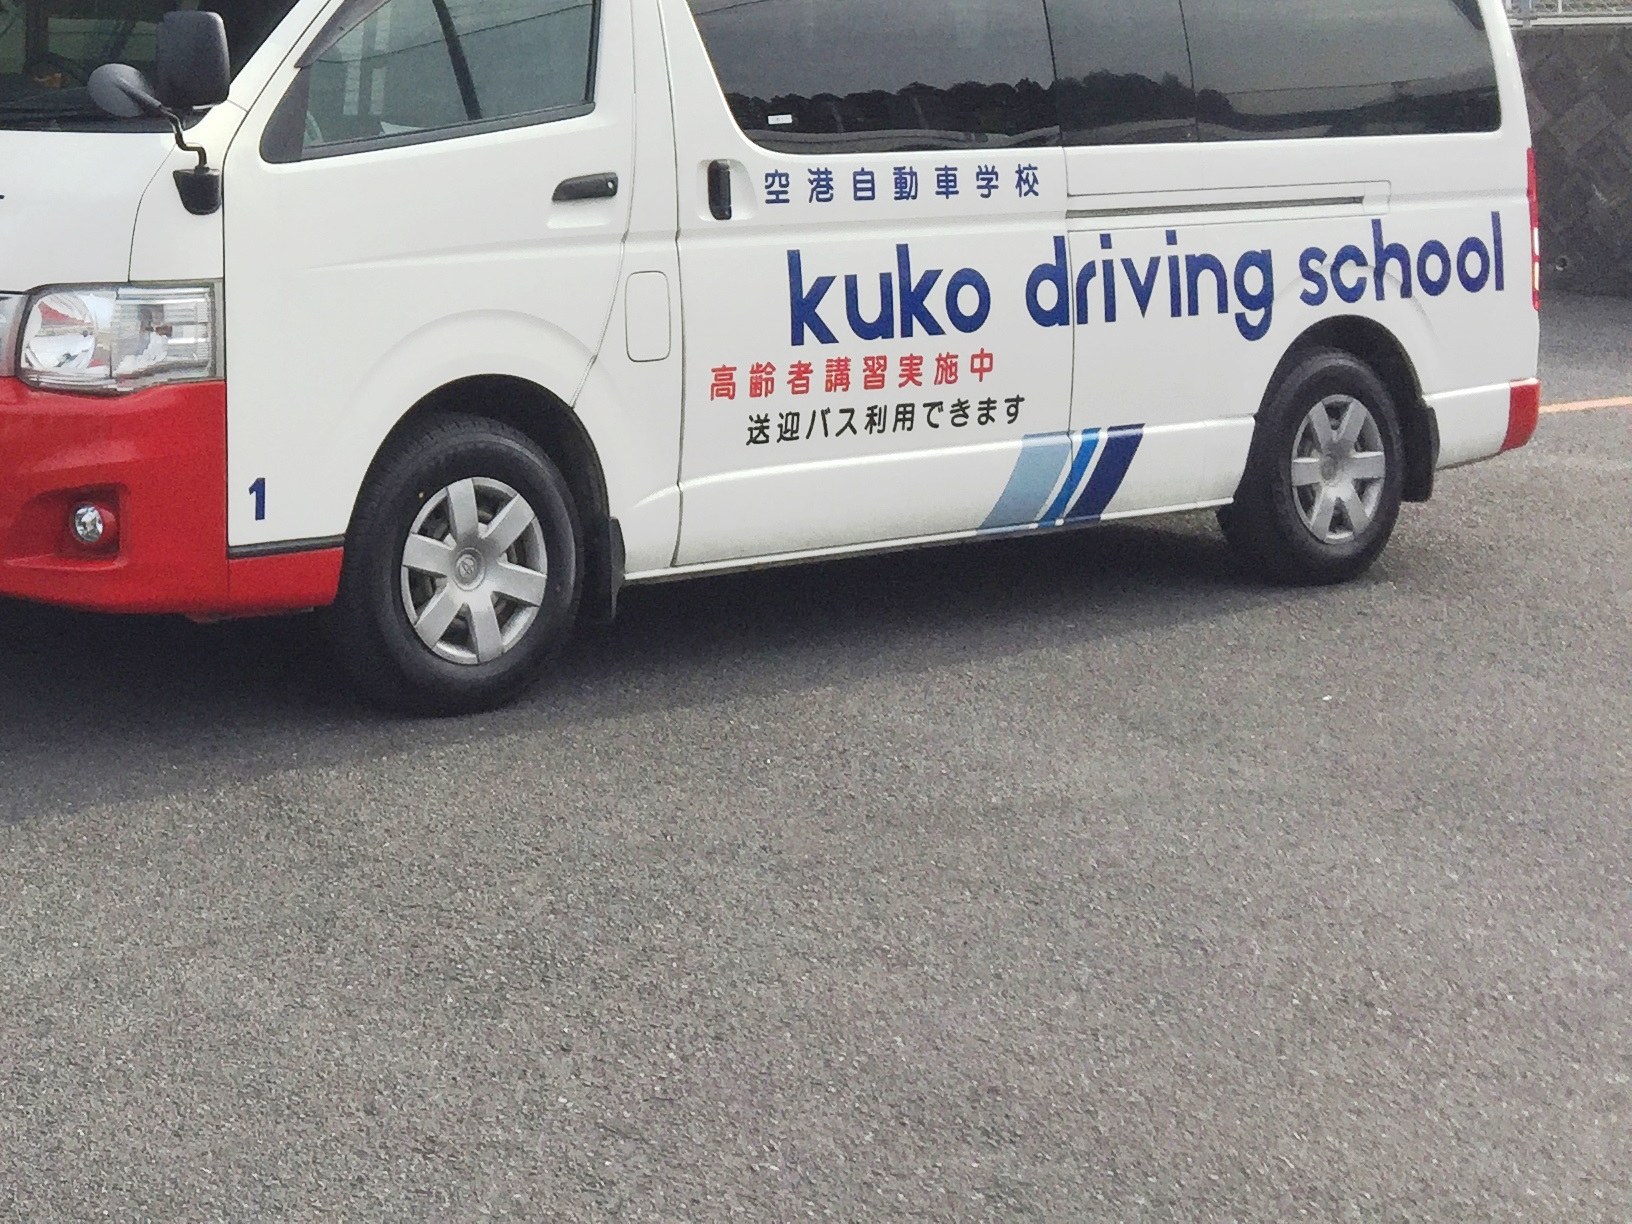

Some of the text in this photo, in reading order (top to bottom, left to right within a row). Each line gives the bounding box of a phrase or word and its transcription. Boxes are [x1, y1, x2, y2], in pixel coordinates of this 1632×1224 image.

[764, 164, 1040, 204] 空港自動車学校
[787, 211, 1504, 346] kuko driving school
[710, 348, 994, 401] 高齢者講習実施中
[745, 394, 1026, 446] 送迎バス利用できます
[248, 477, 265, 521] 1
